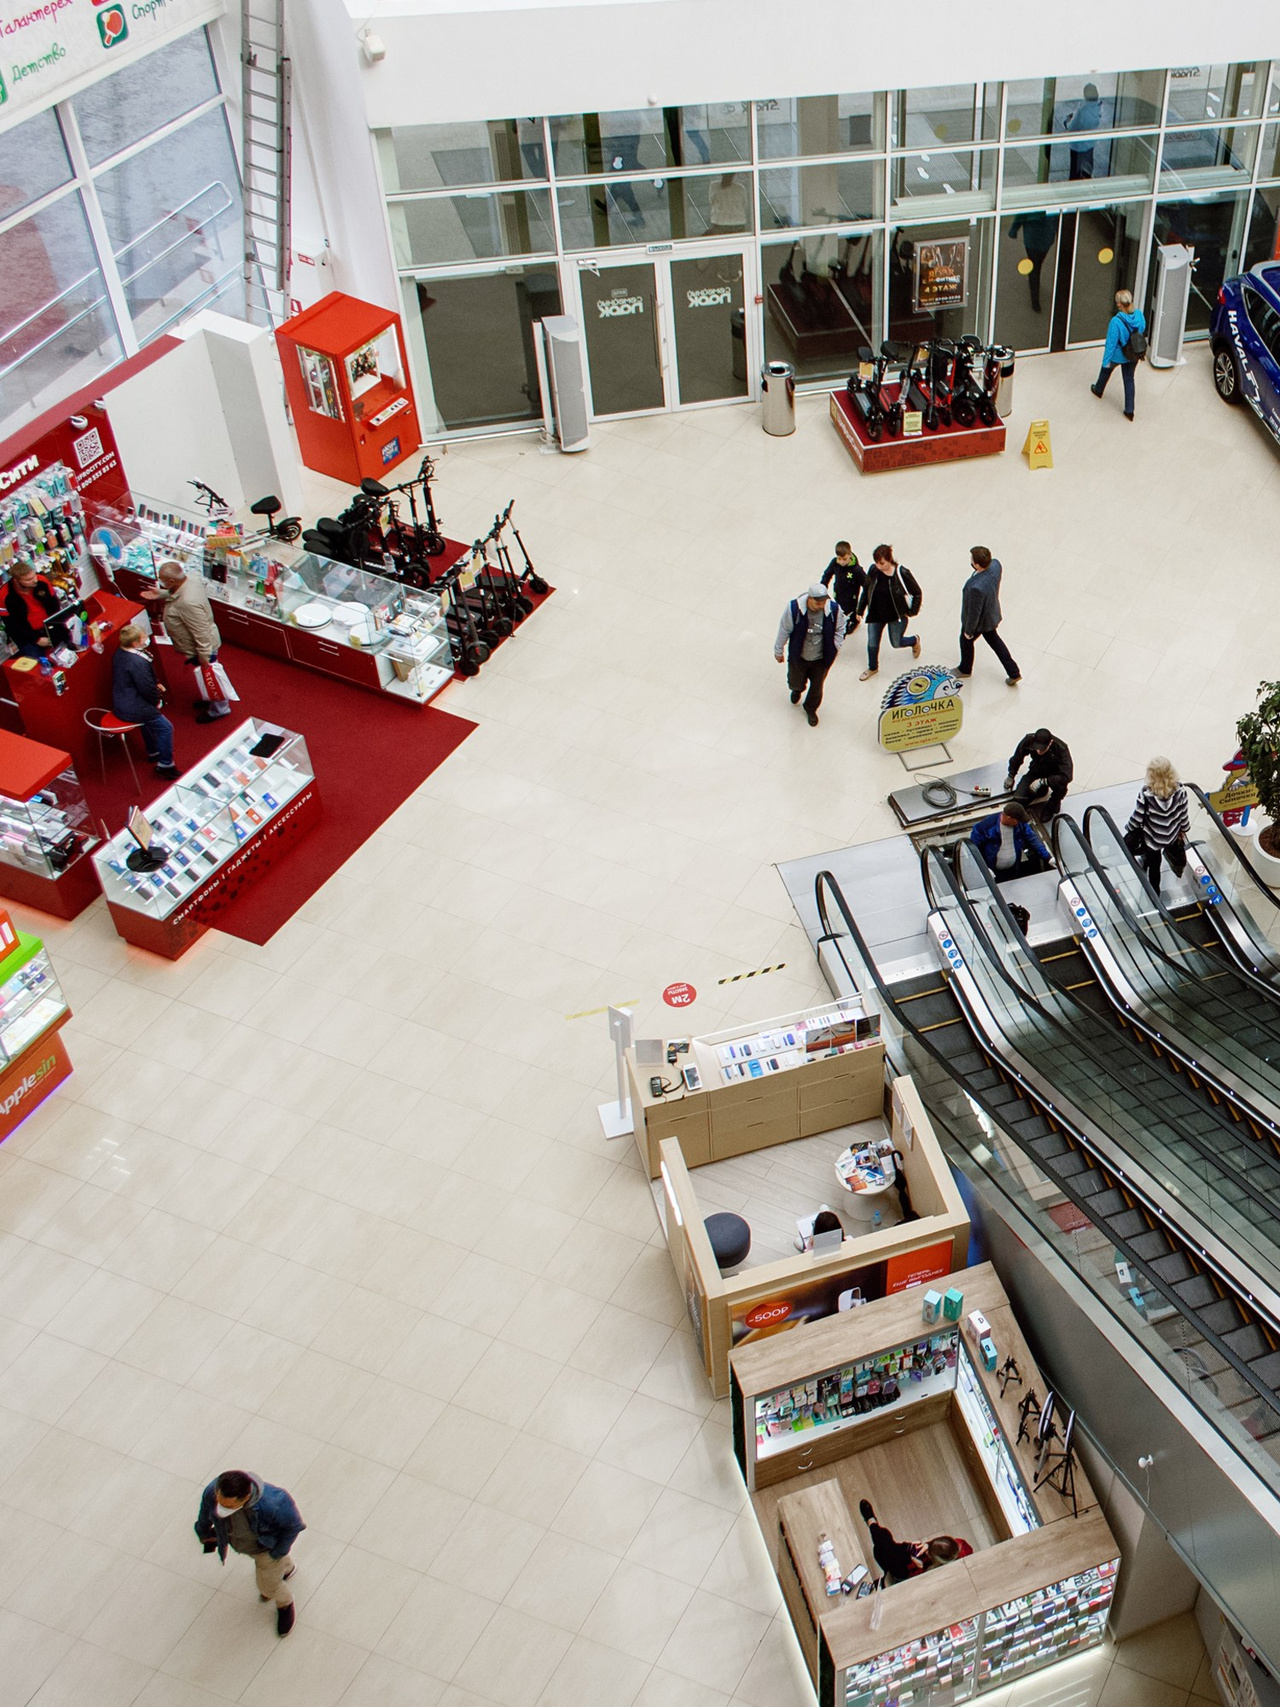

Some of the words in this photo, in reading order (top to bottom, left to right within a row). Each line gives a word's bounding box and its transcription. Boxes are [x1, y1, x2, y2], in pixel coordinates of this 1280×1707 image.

[12, 42, 67, 83] Детство
[932, 283, 958, 293] ЭТАЖ
[1227, 310, 1248, 372] HAVAL
[914, 718, 937, 726] ЭТАЖ
[1218, 792, 1256, 805] Сыночки
[172, 880, 220, 926] СМАРТФОНЫ
[226, 840, 262, 874] ГАДЖЕТЫ
[268, 791, 313, 836] АКСЕССУАРЫ
